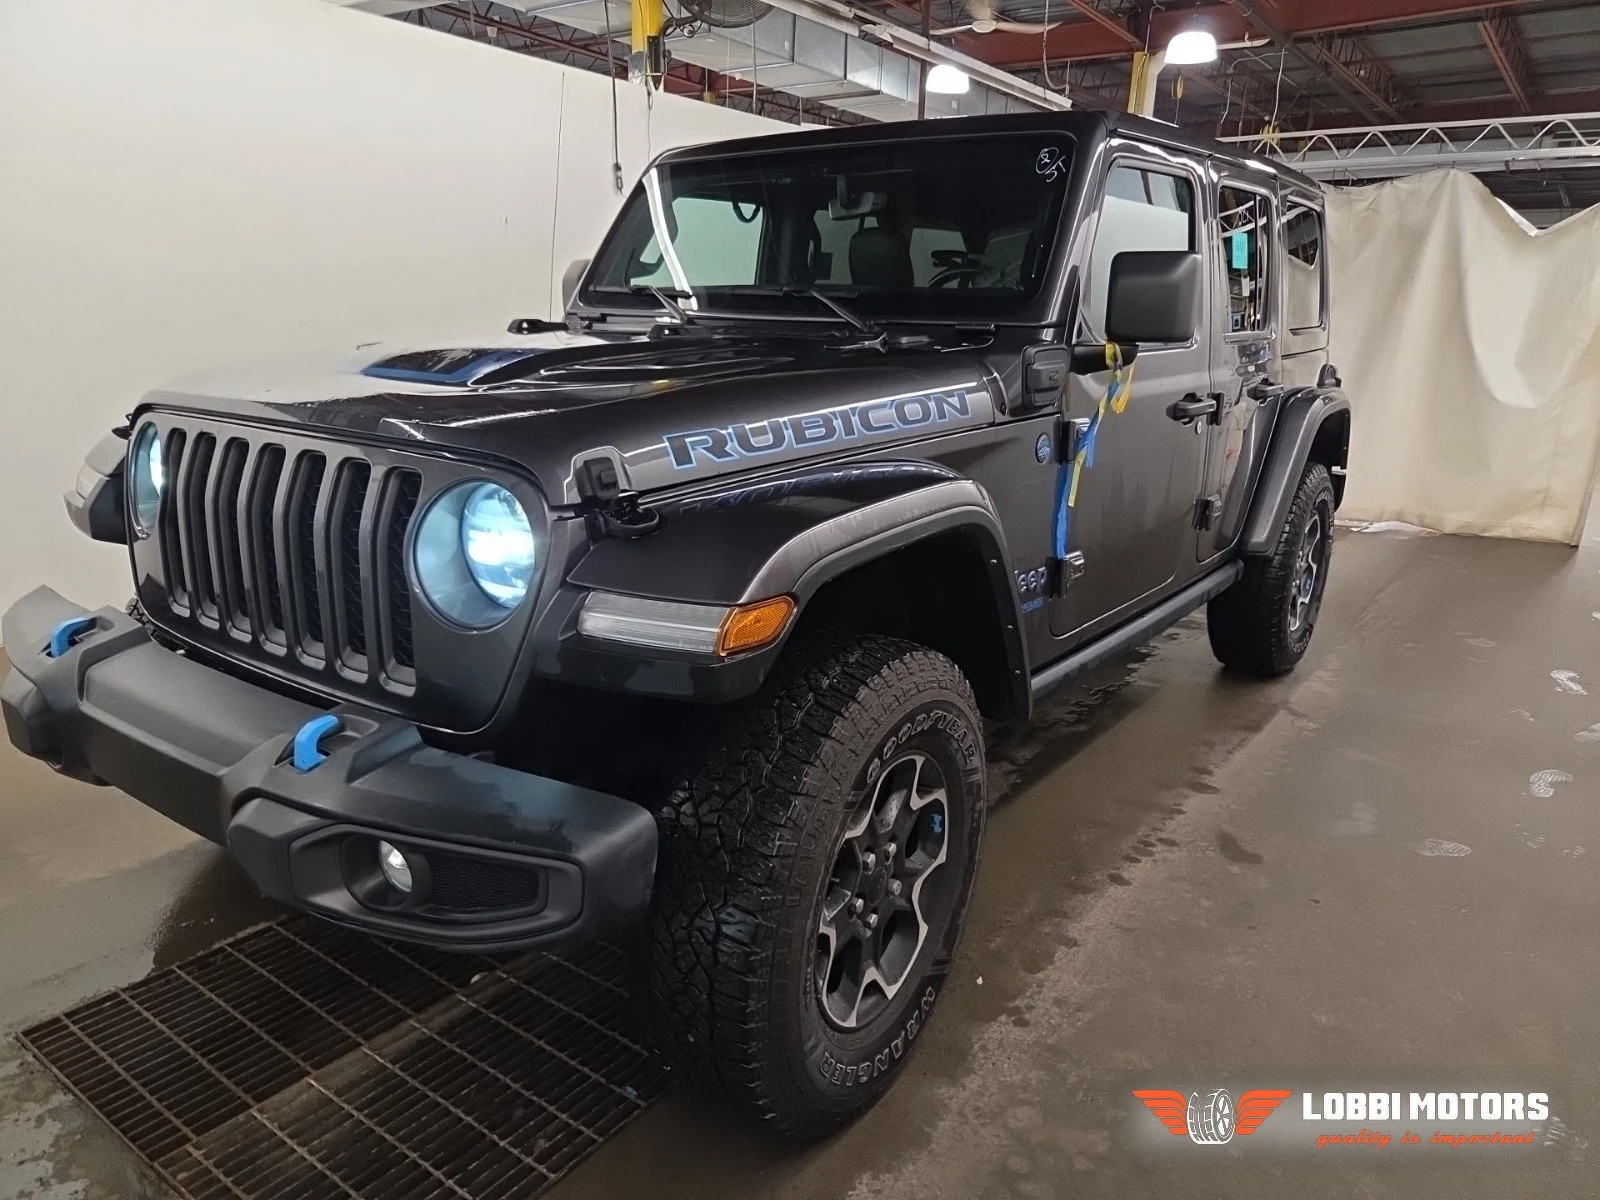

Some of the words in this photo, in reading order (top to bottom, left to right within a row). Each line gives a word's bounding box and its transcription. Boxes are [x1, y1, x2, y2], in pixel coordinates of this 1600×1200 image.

[662, 390, 971, 471] RUBICON
[866, 709, 977, 784] GOODYEAR
[819, 986, 936, 1086] WRANGLER
